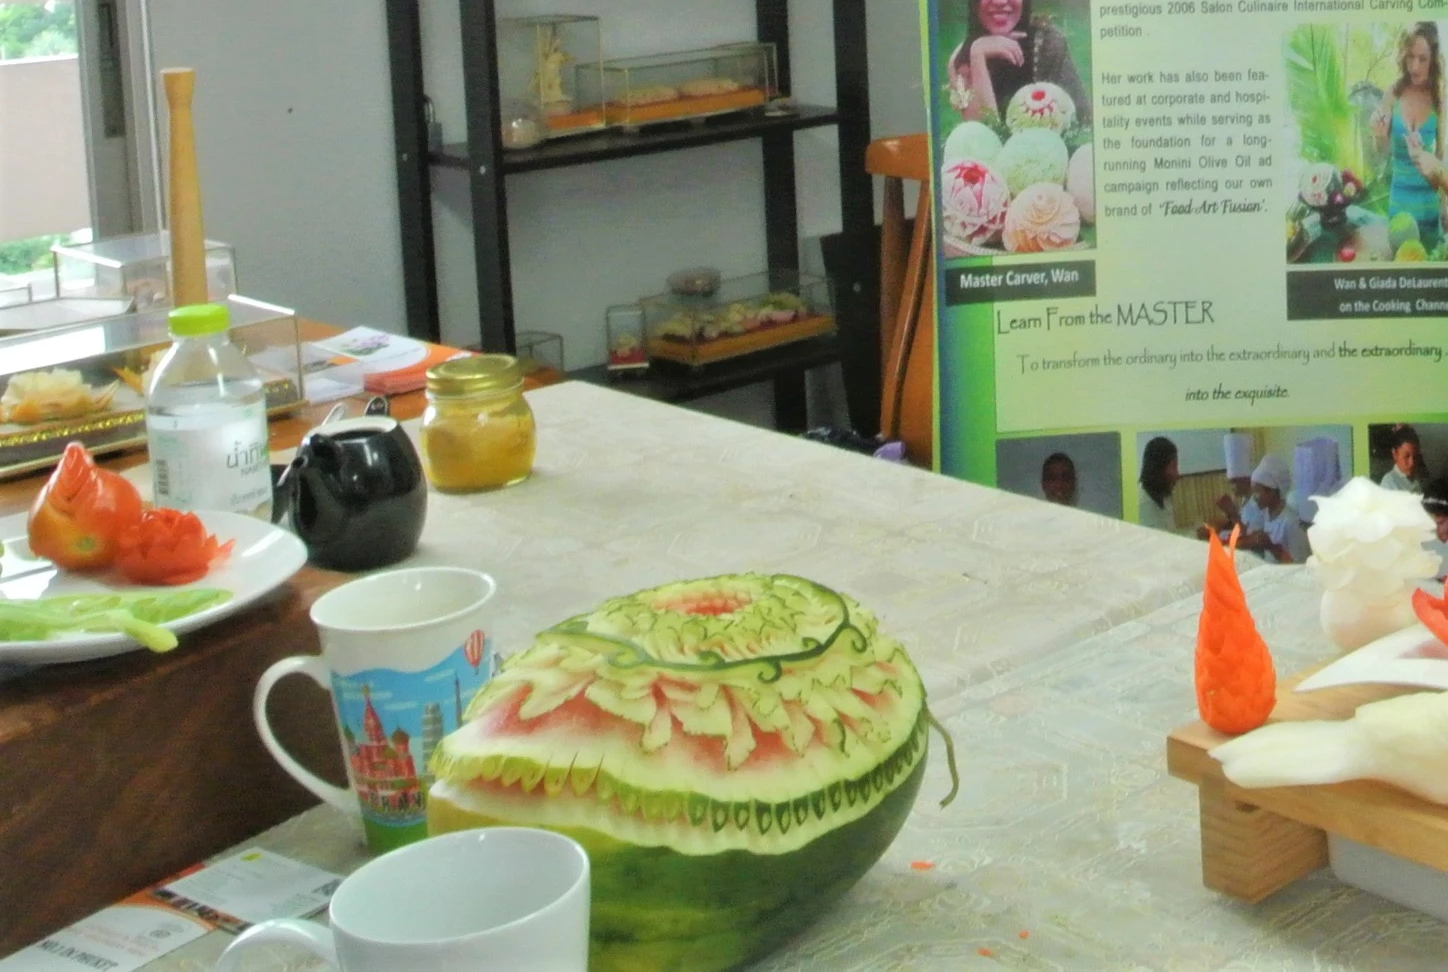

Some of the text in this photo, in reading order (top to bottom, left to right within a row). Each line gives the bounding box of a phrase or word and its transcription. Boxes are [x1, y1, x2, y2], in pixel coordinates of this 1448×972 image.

[1099, 2, 1162, 19] prestigious
[1167, 0, 1196, 15] 2006
[1200, 0, 1233, 14] Salon
[1099, 24, 1143, 40] petition
[1100, 67, 1269, 84] Her work has also been fea-
[1101, 89, 1269, 108] tured corporate and hospi-
[1101, 112, 1253, 131] tality events while serving
[1101, 132, 1272, 150] the foundation for long-
[1102, 153, 1251, 174] running Monini Olive Oil
[1102, 176, 1273, 196] campaign reflecting our own
[1104, 203, 1137, 217] brand
[1193, 198, 1219, 215] Art
[959, 267, 1079, 288] Master Carver, Wan
[1333, 277, 1356, 290] Wan
[1358, 276, 1366, 290] &
[1368, 276, 1397, 289] Giada
[1339, 301, 1351, 313] on
[1353, 299, 1370, 313] the
[1372, 298, 1410, 314] Cooking
[996, 300, 1215, 335] Learn From the MASTER
[1016, 337, 1442, 375] To transform the ordinary into the extraordinary and the extraordinary
[1185, 382, 1290, 406] into the exquisite.
